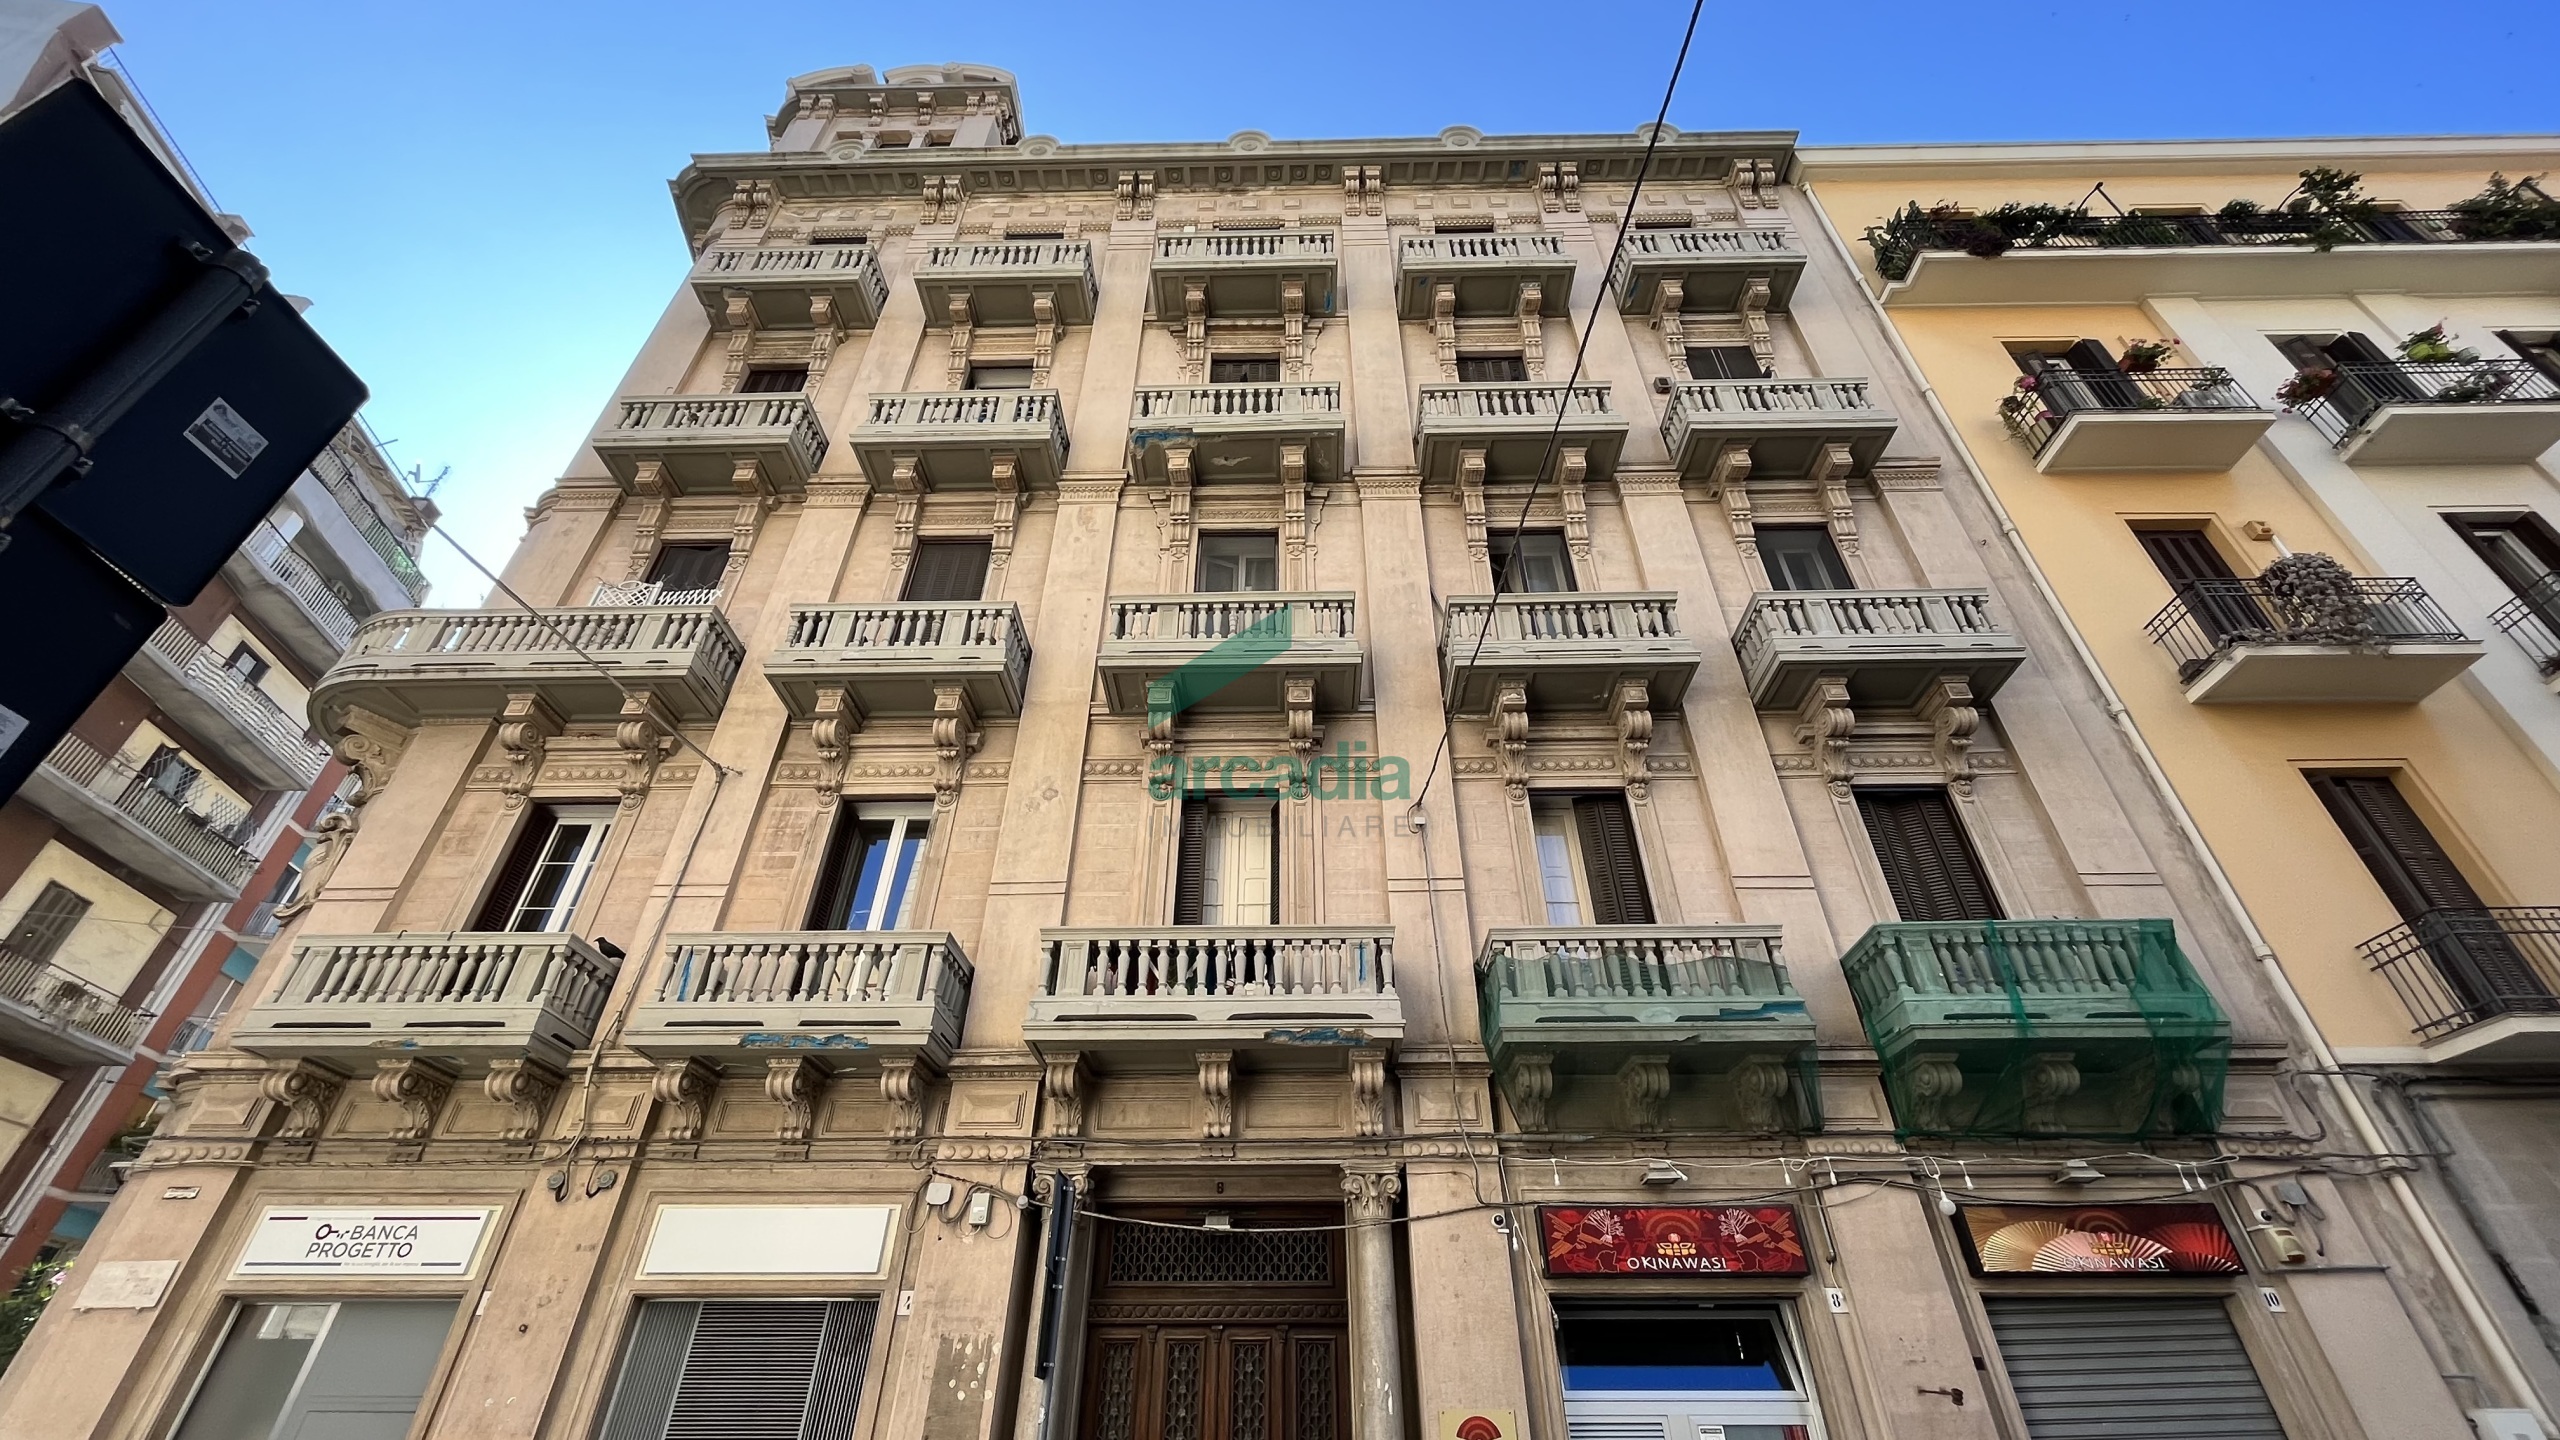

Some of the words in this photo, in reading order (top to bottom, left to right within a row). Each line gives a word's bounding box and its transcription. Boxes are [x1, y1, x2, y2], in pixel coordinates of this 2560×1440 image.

[350, 1225, 418, 1240] BANCA
[305, 1242, 413, 1258] PROGETTO
[1626, 1256, 1727, 1270] OKINAWASI
[2063, 1255, 2166, 1269] OKINAWASI
[1831, 1293, 1841, 1307] 8
[2263, 1292, 2280, 1307] 10
